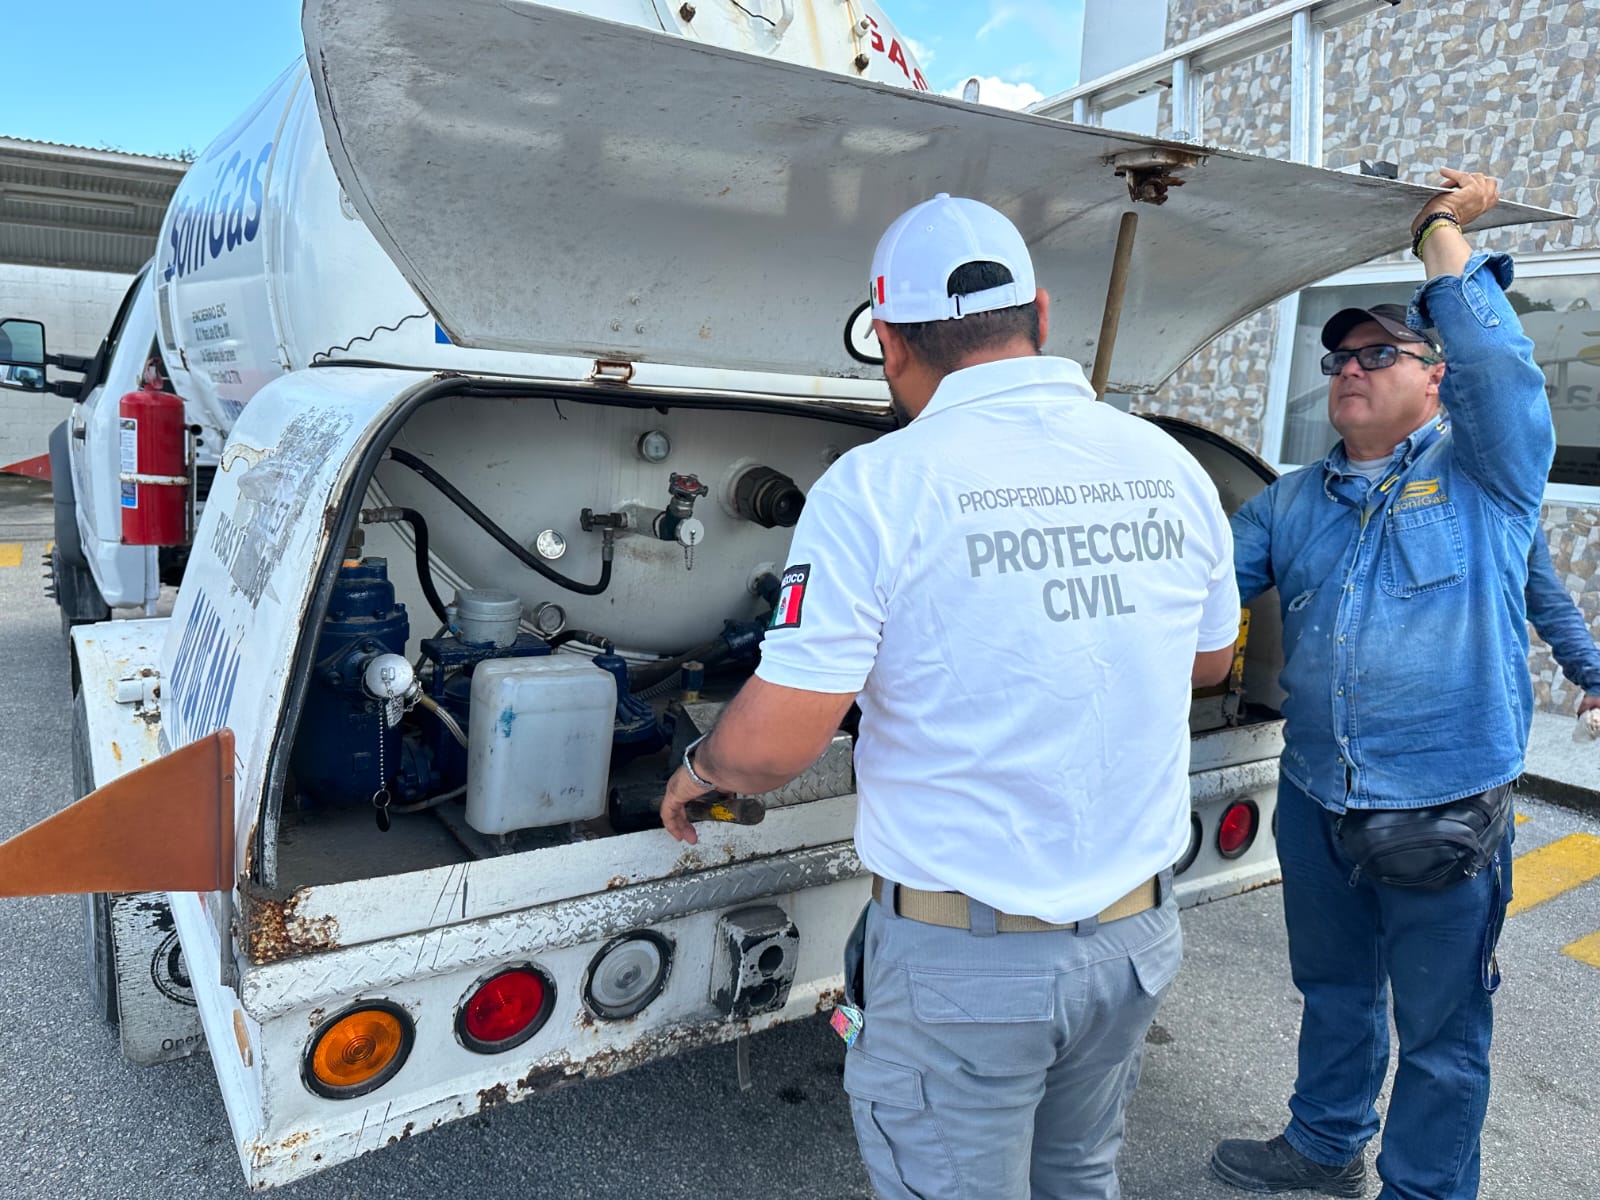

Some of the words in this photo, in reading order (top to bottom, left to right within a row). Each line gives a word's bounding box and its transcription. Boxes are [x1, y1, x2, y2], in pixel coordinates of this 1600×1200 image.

[958, 485, 1077, 514] PROSPERIDAD
[1079, 482, 1124, 503] PARA
[1124, 479, 1175, 500] TODOS
[965, 508, 1185, 577] PROTECCIÓN
[1042, 573, 1136, 622] CIVIL
